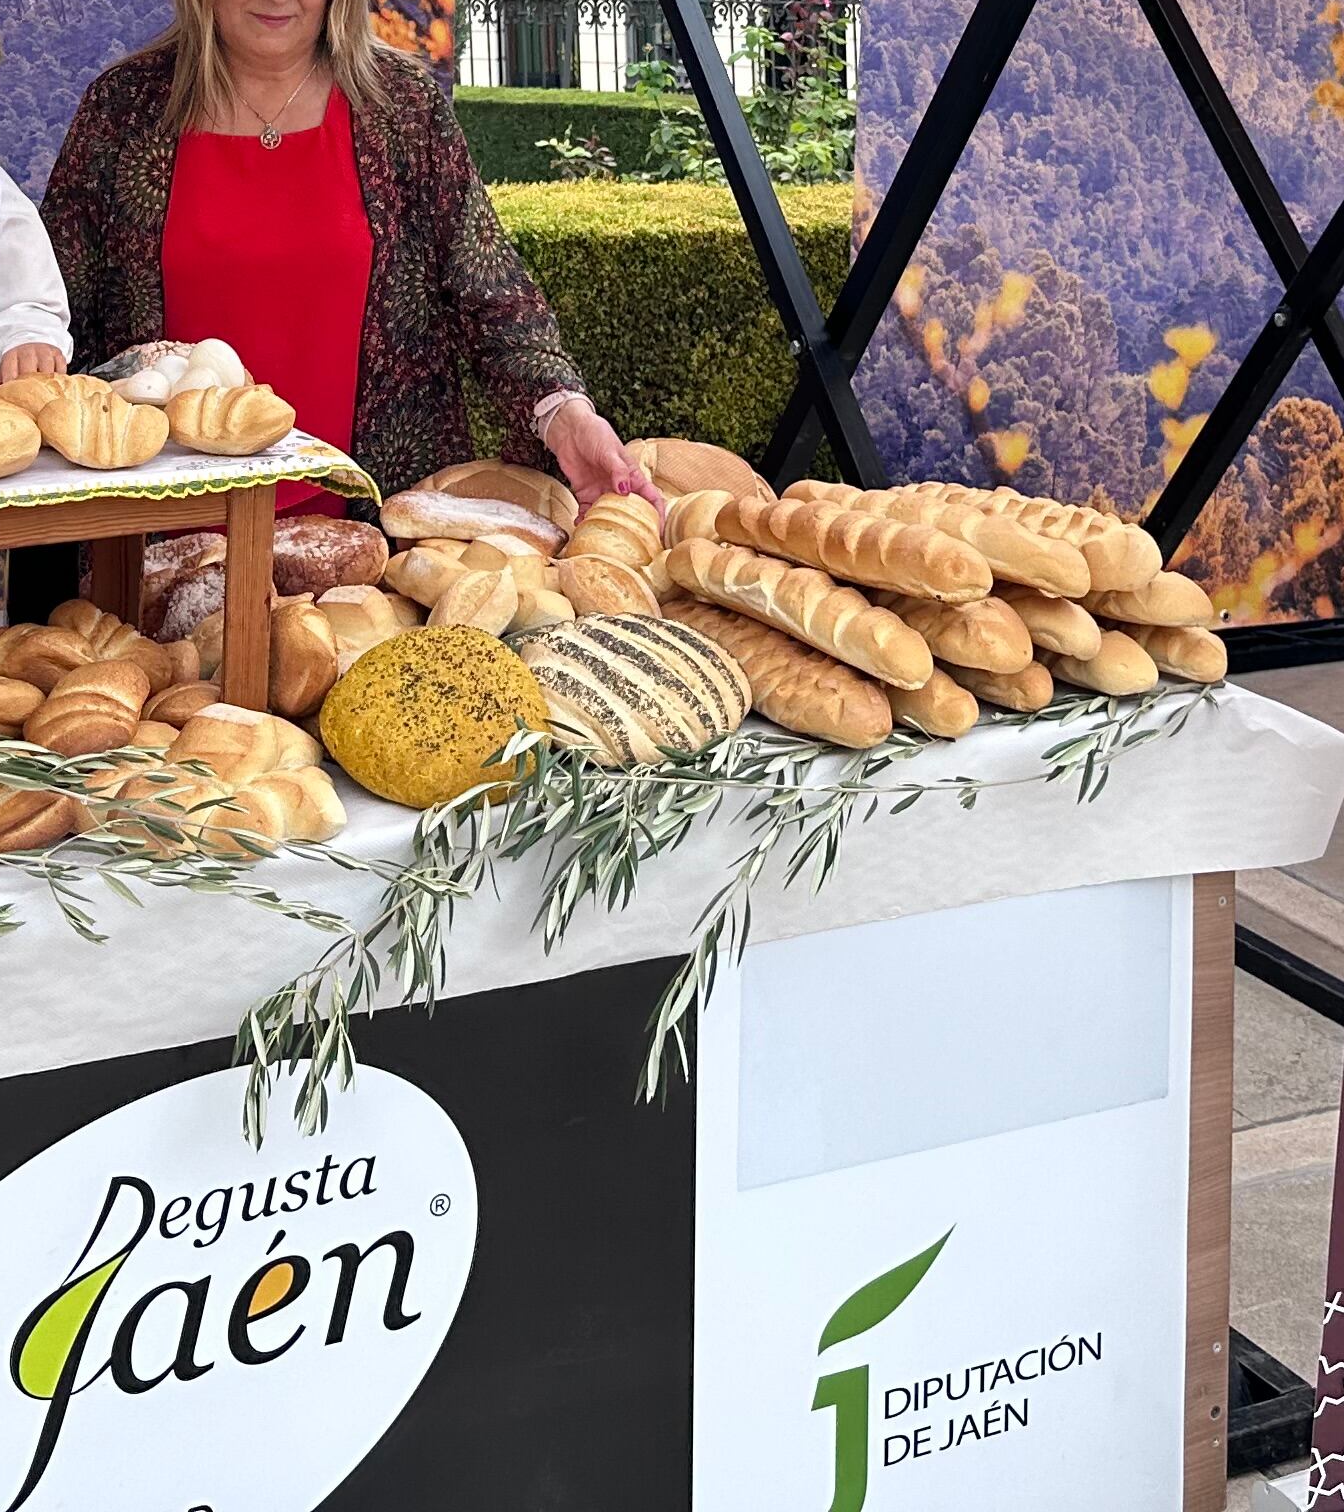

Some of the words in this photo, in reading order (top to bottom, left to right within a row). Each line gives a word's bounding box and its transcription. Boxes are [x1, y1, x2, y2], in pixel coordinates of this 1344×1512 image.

[62, 1154, 376, 1273] Degusta
[8, 1229, 421, 1512] Jaén
[884, 1333, 1102, 1419] DIPUTACIÓN
[883, 1426, 932, 1467] DE
[939, 1398, 1029, 1450] JAÉN
